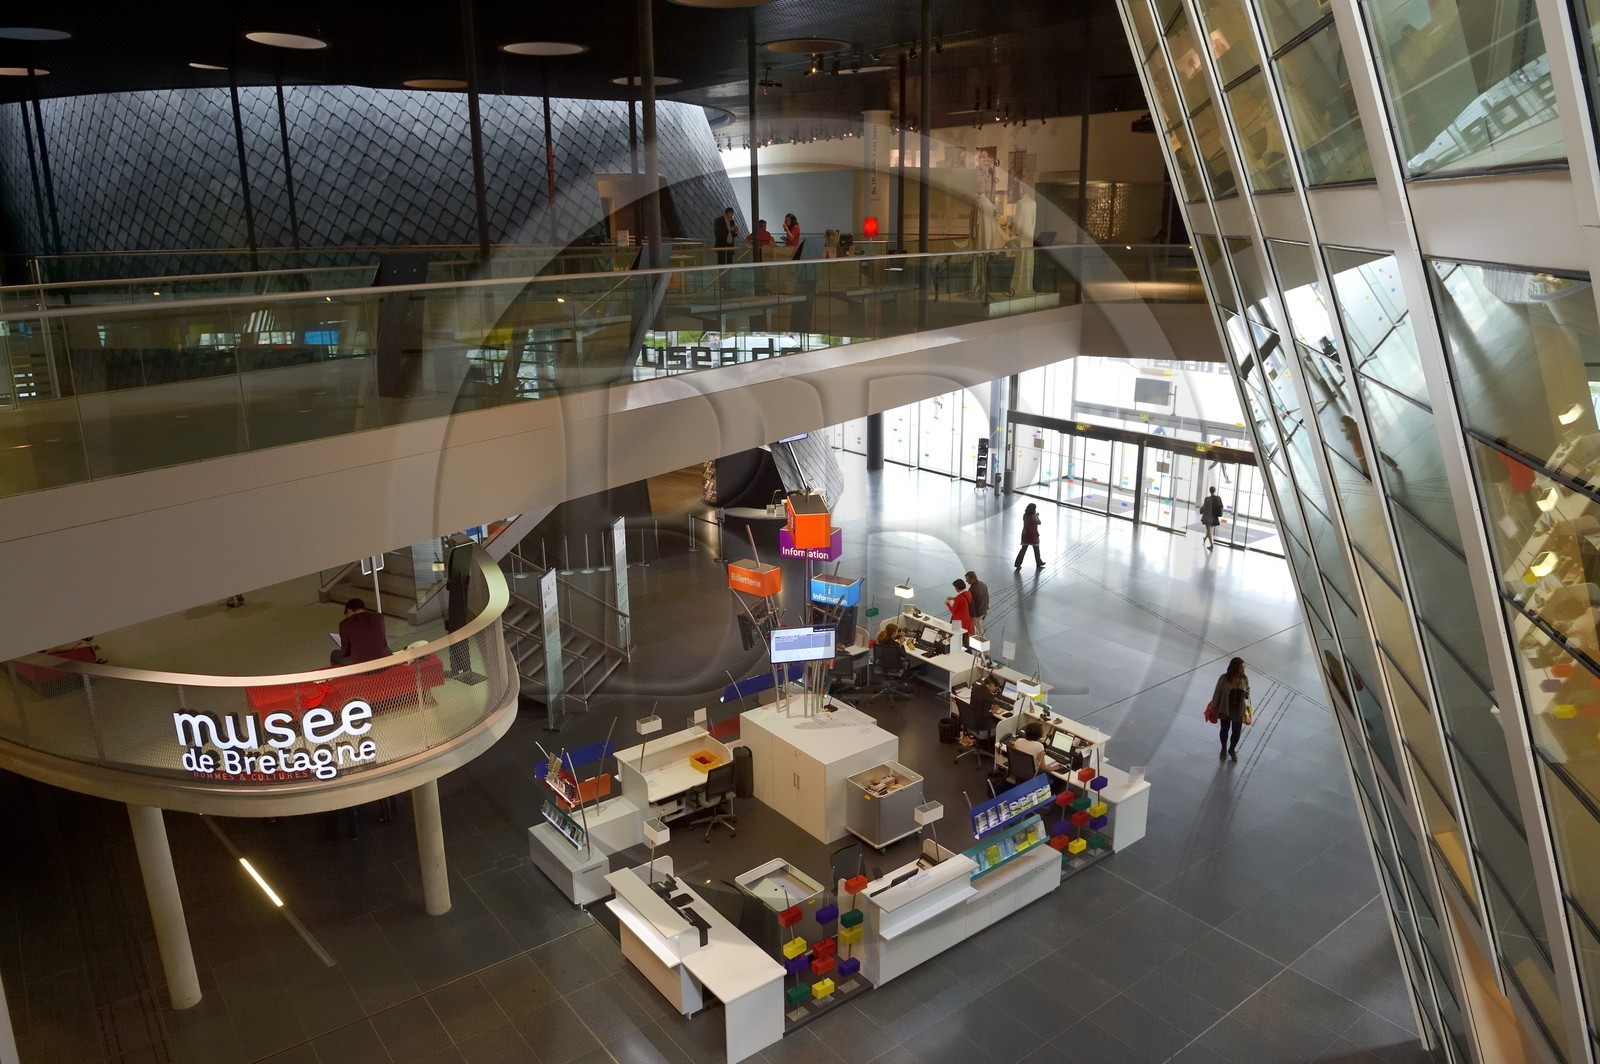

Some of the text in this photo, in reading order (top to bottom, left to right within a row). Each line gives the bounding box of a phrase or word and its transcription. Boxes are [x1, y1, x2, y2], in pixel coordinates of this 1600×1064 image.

[782, 546, 829, 560] Information
[731, 573, 761, 588] Billetterie
[182, 740, 377, 780] de Bretagne
[239, 774, 246, 782] &
[251, 771, 308, 781] CULTURES
